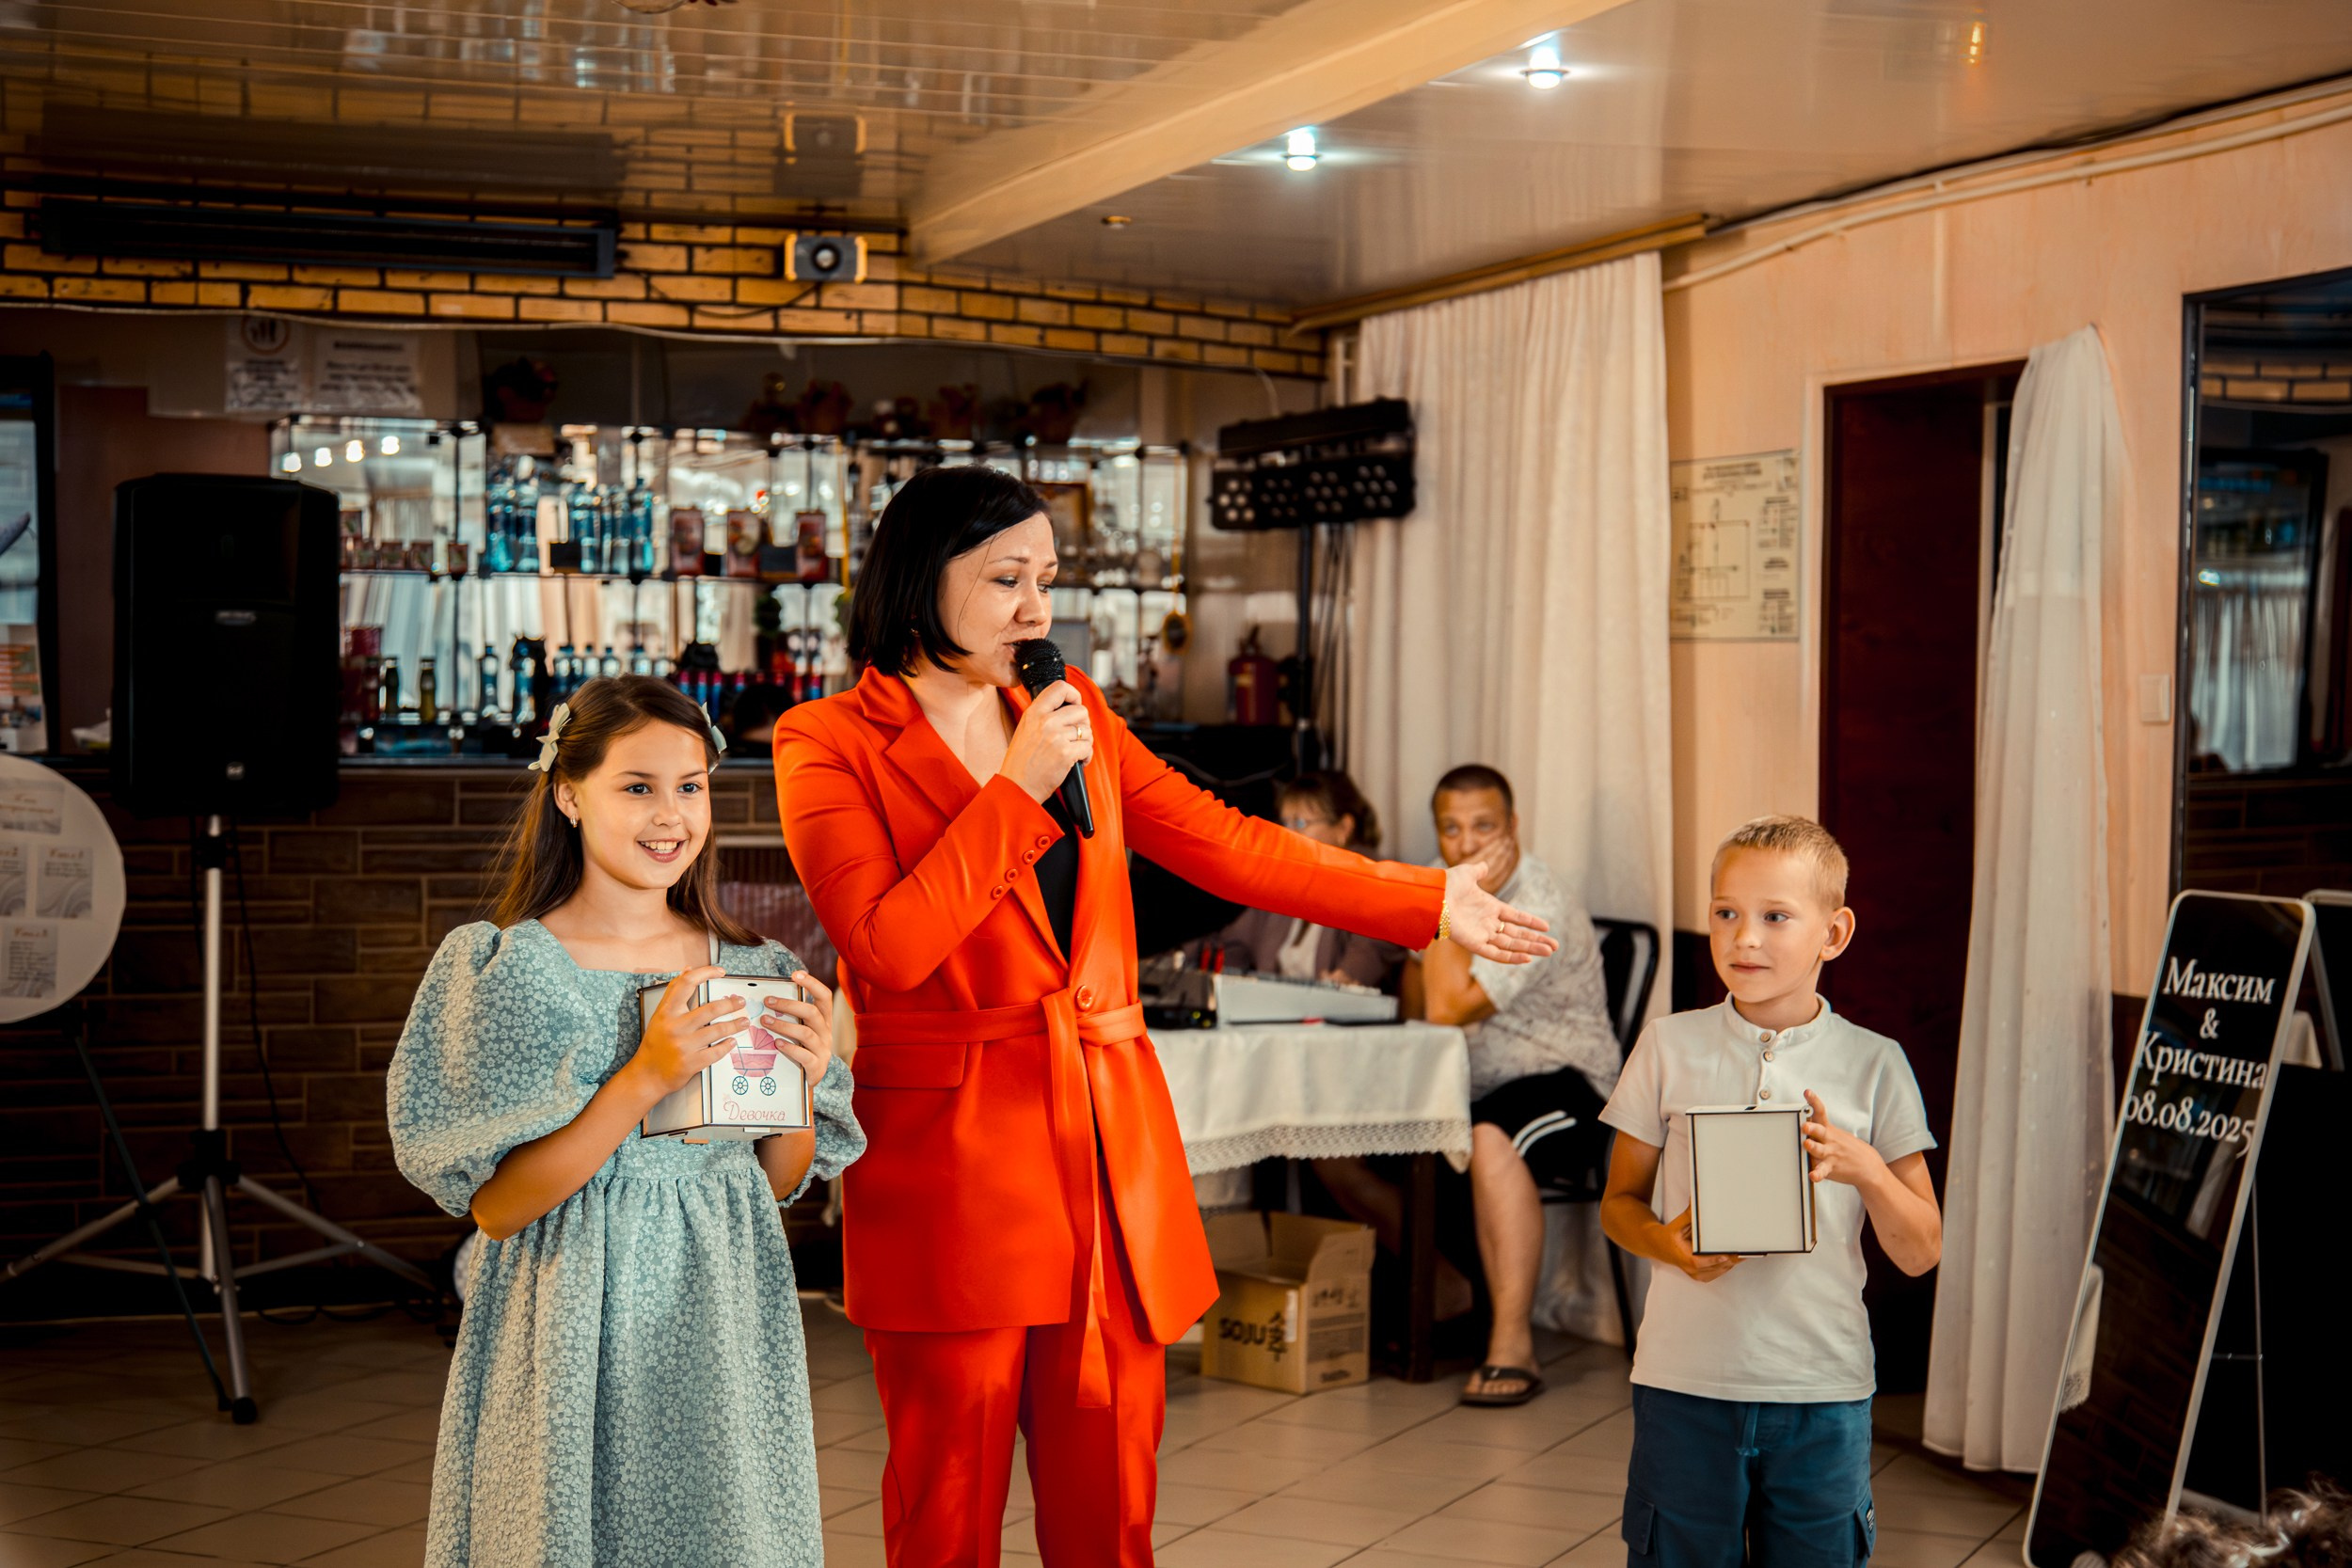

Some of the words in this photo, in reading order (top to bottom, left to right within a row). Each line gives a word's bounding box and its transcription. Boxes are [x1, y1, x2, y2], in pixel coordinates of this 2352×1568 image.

[2162, 957, 2276, 1004] Максим
[2200, 1007, 2219, 1039] &
[2138, 1031, 2269, 1090] Кристина
[723, 1101, 787, 1122] Девочка
[2125, 1090, 2256, 1159] 08.08.2025
[1218, 1317, 1266, 1345] SOJU
